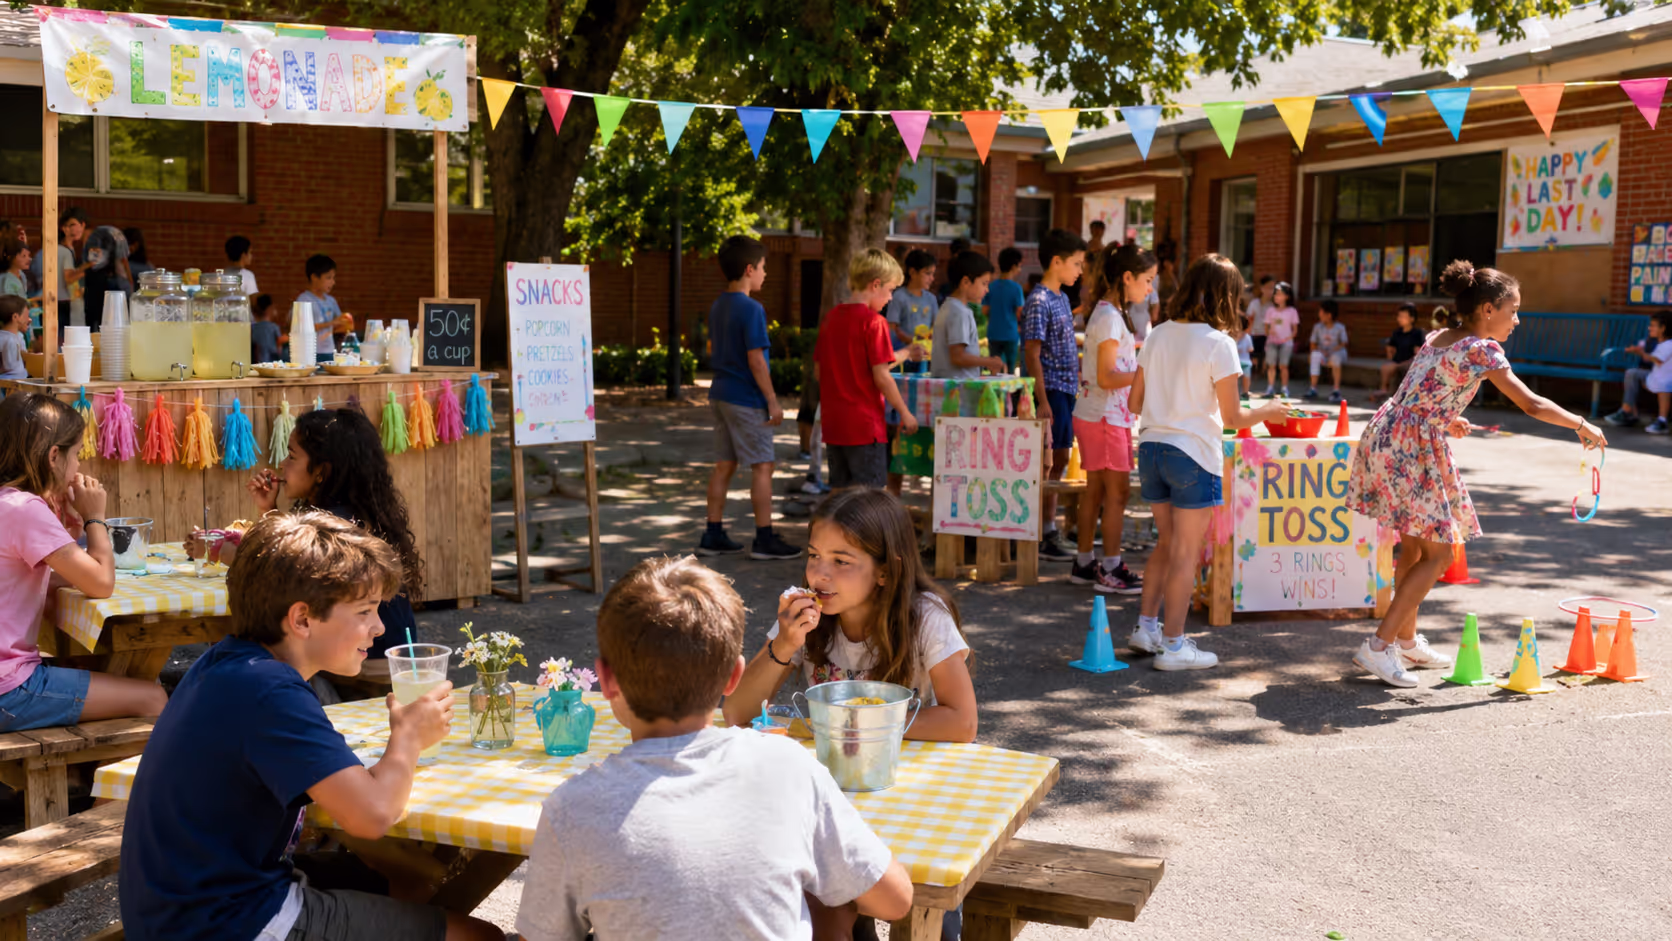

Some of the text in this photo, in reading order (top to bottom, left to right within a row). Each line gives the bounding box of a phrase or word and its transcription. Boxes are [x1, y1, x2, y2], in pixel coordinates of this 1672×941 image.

[130, 40, 409, 116] LEMONADE
[1525, 150, 1587, 179] HAPPY
[1527, 178, 1577, 204] LAST
[1527, 203, 1585, 233] DAY!
[516, 278, 584, 305] SNACKS
[429, 309, 471, 337] 50¢
[526, 319, 570, 337] POPCORN
[427, 345, 471, 365] a cup
[527, 345, 574, 361] PRETZELS
[528, 368, 569, 386] COOKIES
[945, 424, 1031, 472] RING
[1262, 462, 1350, 500] RING
[943, 474, 1030, 525] TOSS
[1260, 506, 1350, 543] TOSS
[1270, 552, 1283, 573] 3
[1281, 577, 1336, 600] WINS!
